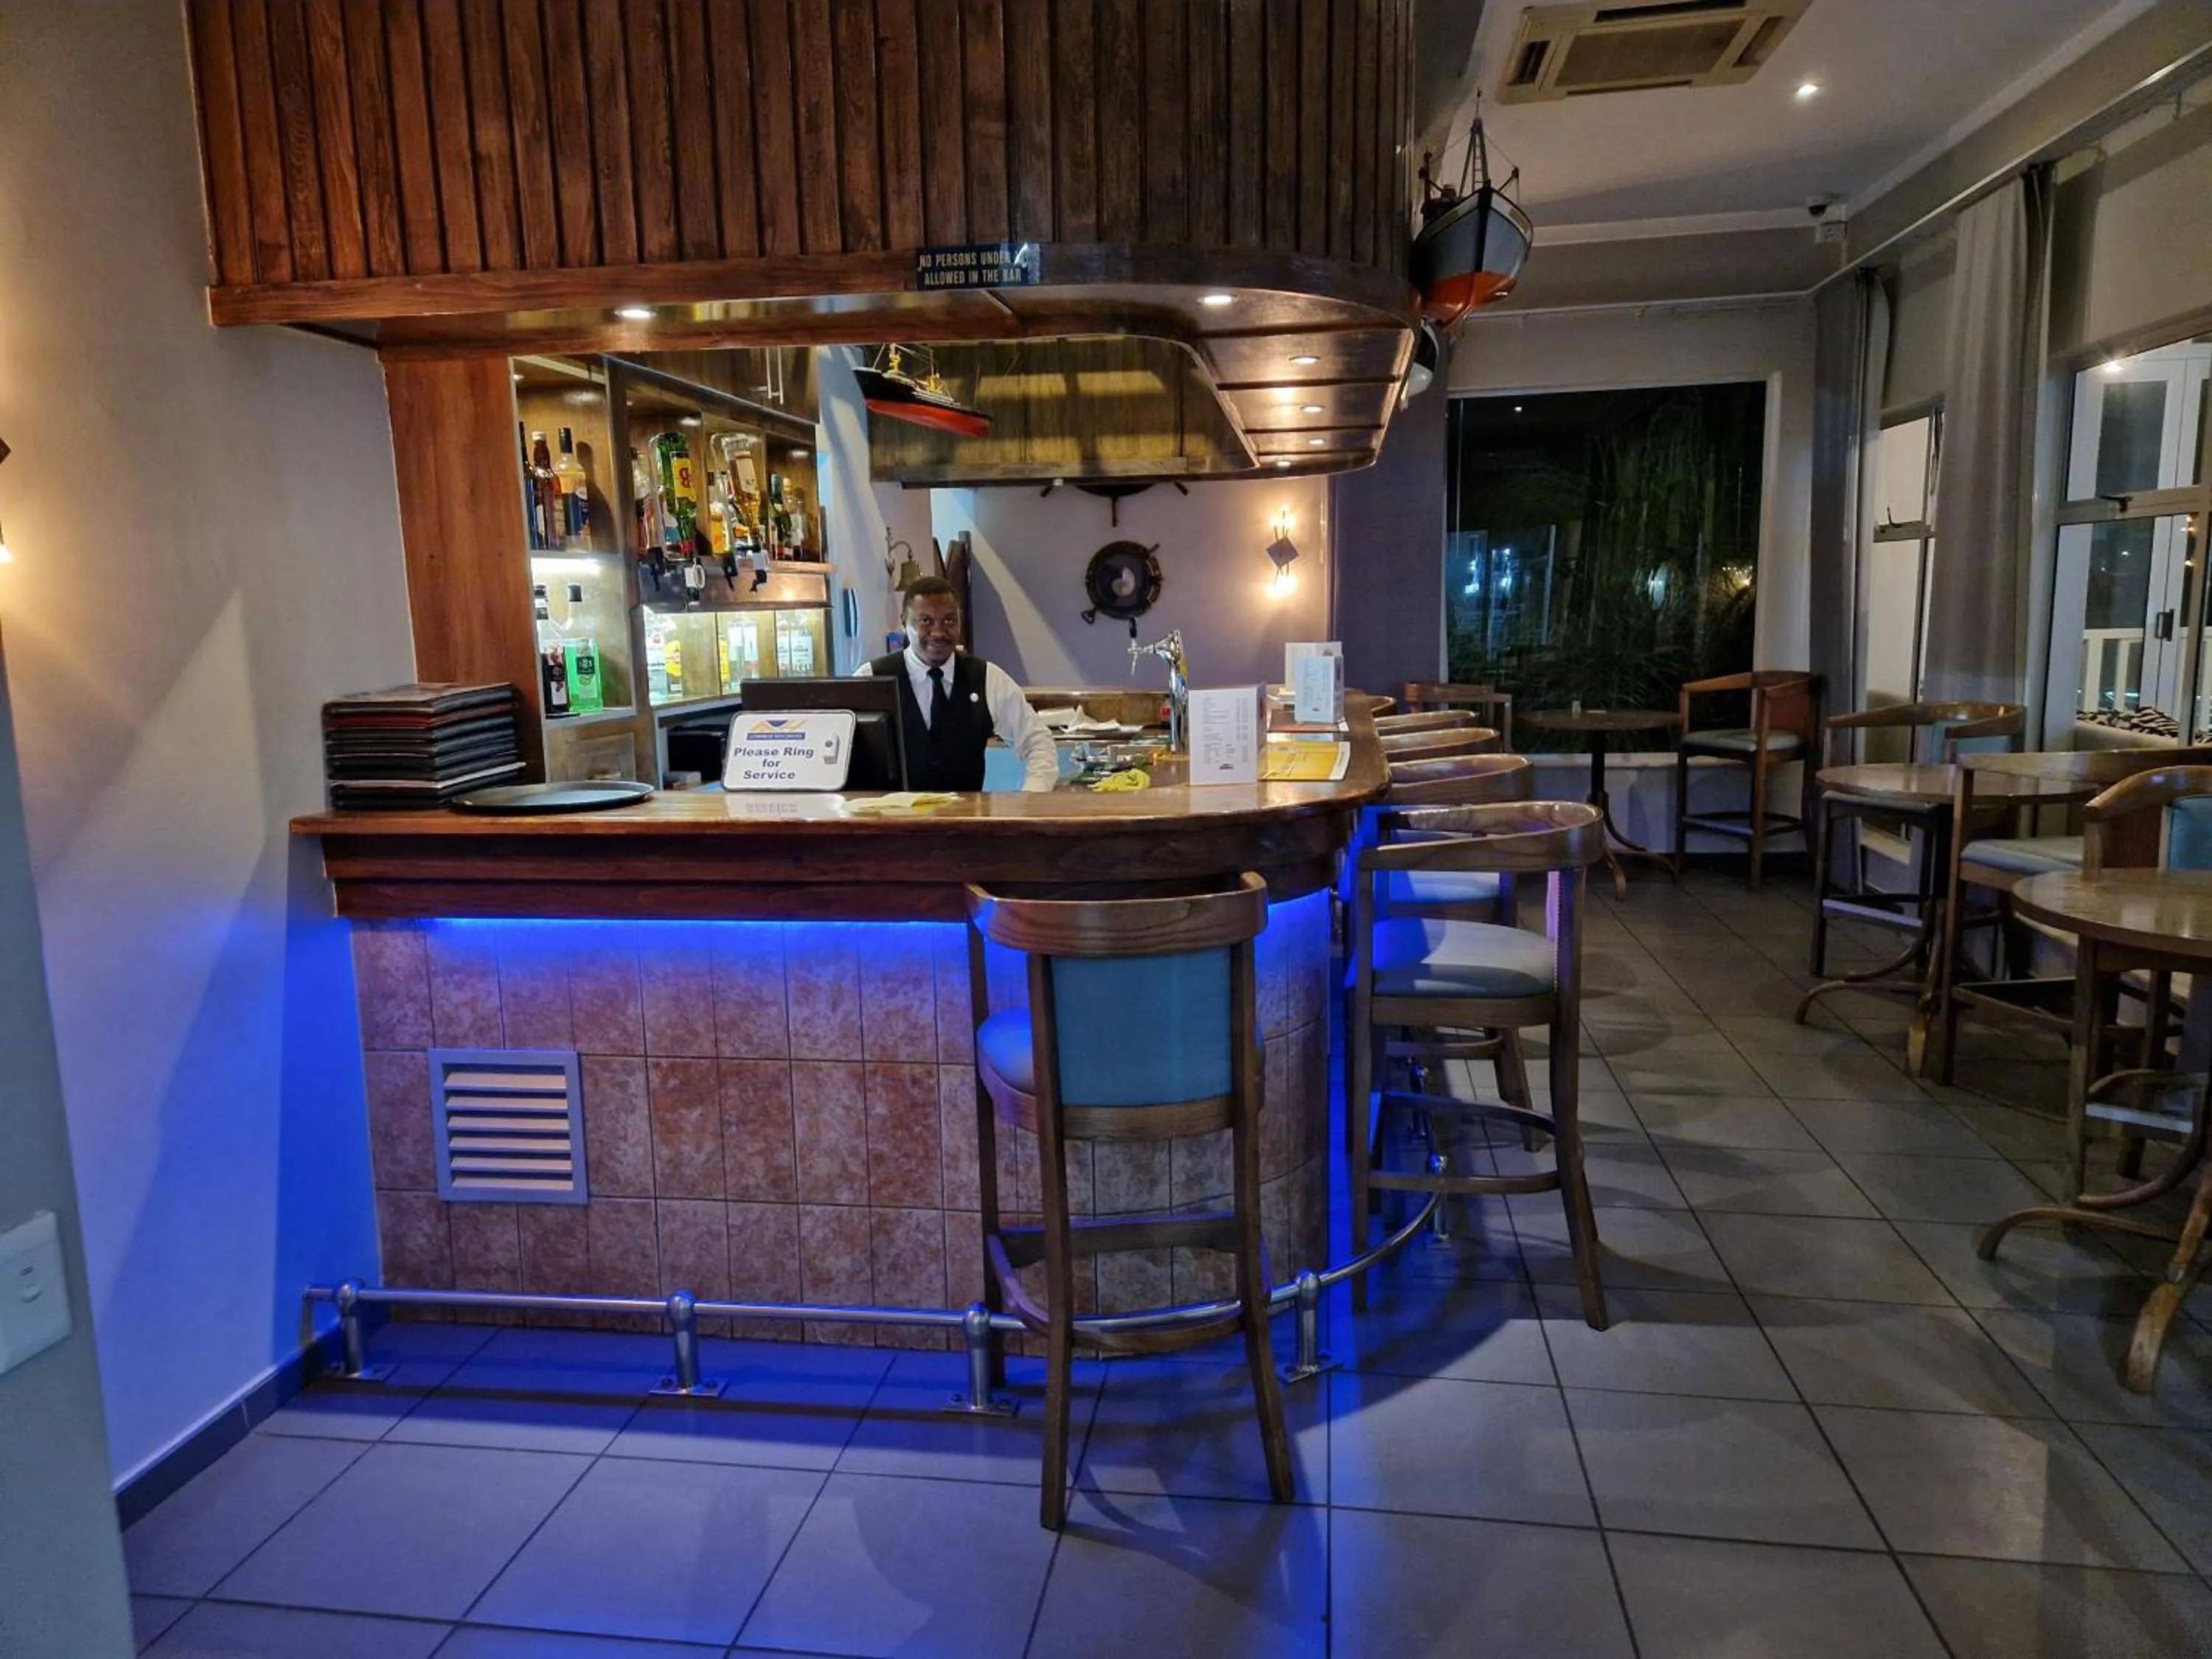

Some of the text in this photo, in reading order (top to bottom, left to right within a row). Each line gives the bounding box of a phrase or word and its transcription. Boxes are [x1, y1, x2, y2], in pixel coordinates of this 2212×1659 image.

[936, 253, 977, 267] PERSONS
[980, 251, 1010, 265] UNDER
[924, 268, 1022, 285] ALLOWED IN THE BAR
[734, 746, 814, 759] Please Ring
[762, 759, 782, 768] for
[743, 770, 796, 779] Service
